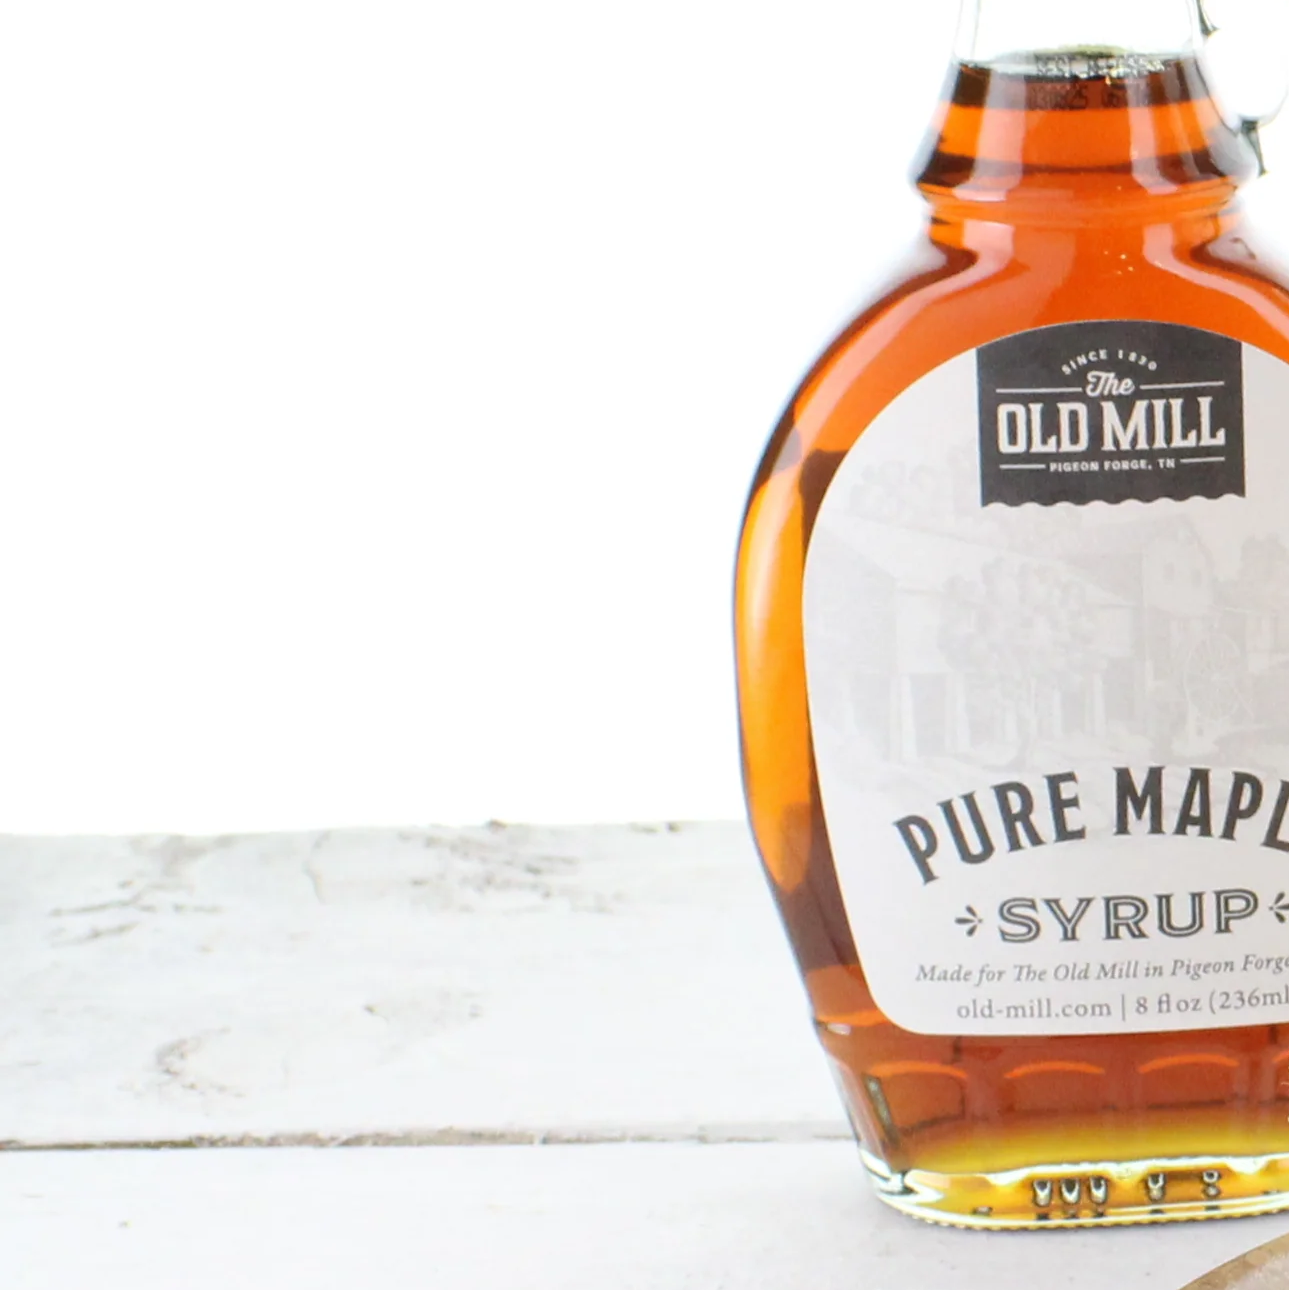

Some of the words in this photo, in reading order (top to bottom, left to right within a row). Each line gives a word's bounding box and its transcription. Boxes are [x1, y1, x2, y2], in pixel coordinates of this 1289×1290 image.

[1061, 349, 1107, 375] SINCE
[1117, 349, 1158, 371] 1830
[1085, 370, 1135, 397] The
[997, 402, 1088, 454] OLD
[1100, 396, 1226, 451] MILL
[1049, 461, 1100, 472] PIGEON
[1103, 459, 1153, 471] FORGE,
[1158, 458, 1176, 469] TN
[892, 770, 1086, 885] PURE
[998, 888, 1259, 944] SYRUP
[915, 963, 973, 983] Made
[975, 963, 1005, 988] for
[1013, 964, 1048, 983] The
[1053, 962, 1090, 982] Old
[1094, 960, 1141, 981] Mill
[1144, 960, 1165, 978] in
[1169, 956, 1236, 982] Pigeon
[956, 996, 1112, 1020] old-mill.com
[1135, 996, 1149, 1015] 8
[1176, 997, 1203, 1013] oz
